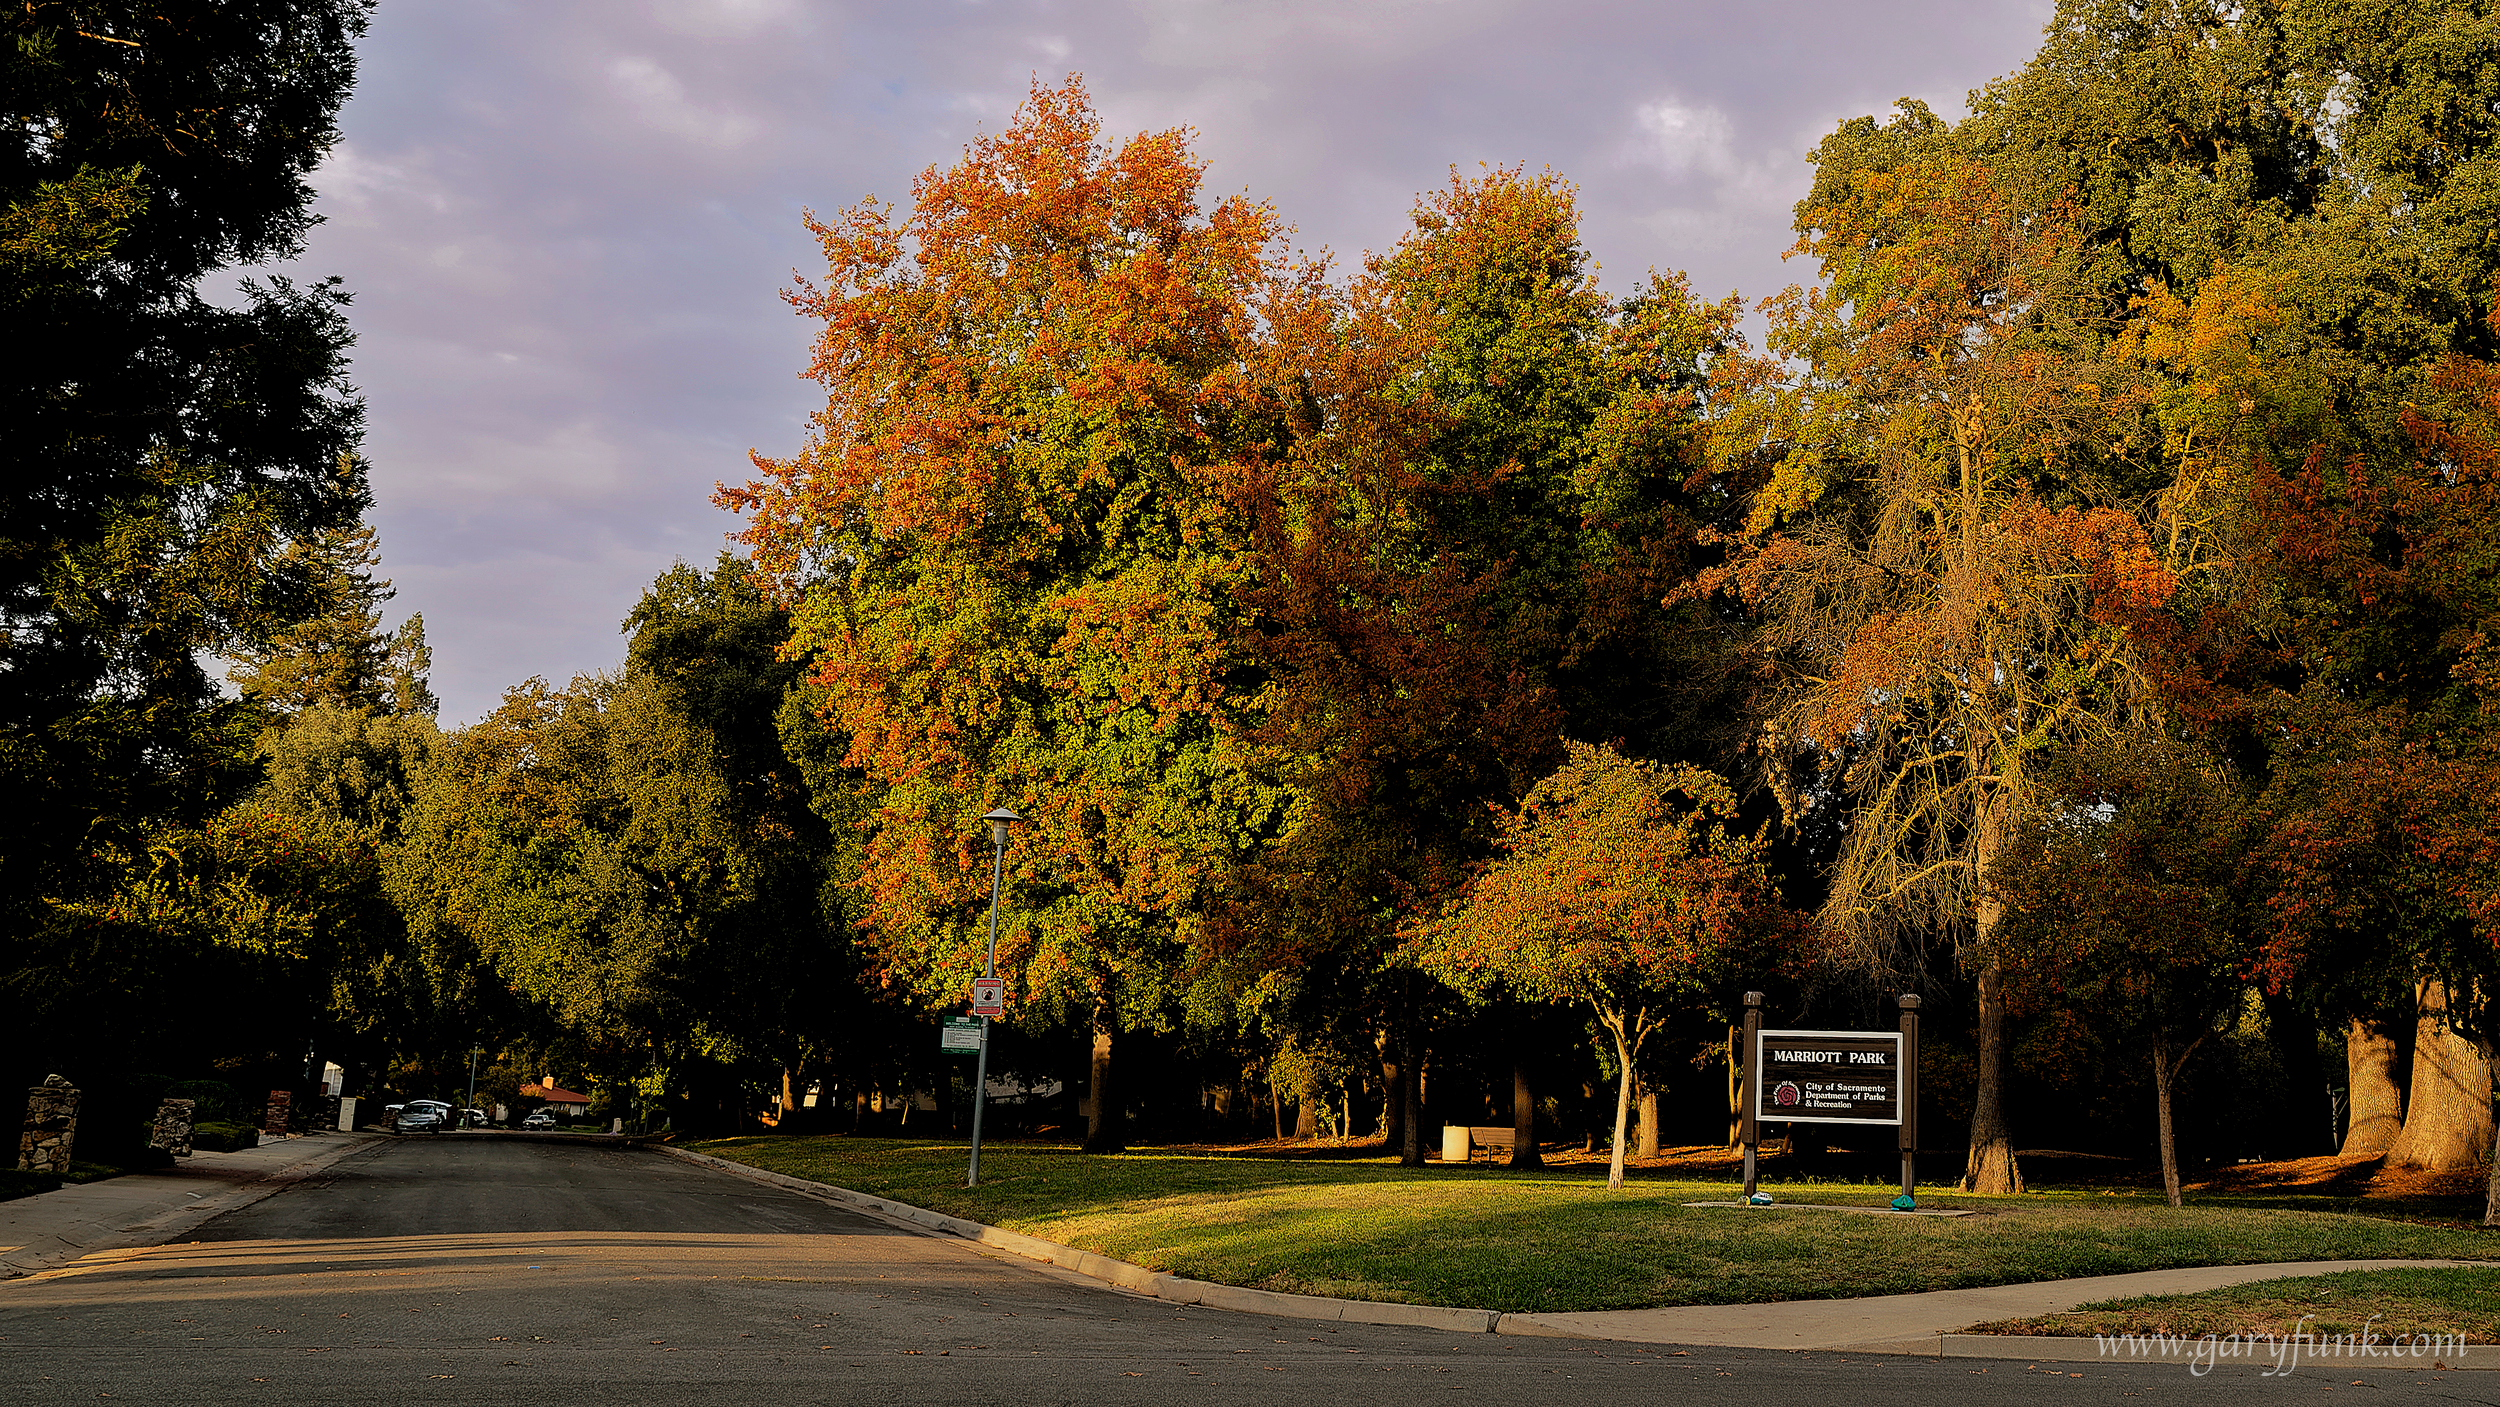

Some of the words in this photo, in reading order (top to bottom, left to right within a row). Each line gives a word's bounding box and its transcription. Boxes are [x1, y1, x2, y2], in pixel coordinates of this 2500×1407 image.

[1774, 1050, 1842, 1063] MARRIOTT
[1849, 1052, 1885, 1064] PARK
[1805, 1082, 1822, 1092] City
[1825, 1083, 1835, 1091] of
[1836, 1083, 1886, 1093] Sacramento
[1805, 1091, 1849, 1102] Department
[1852, 1092, 1861, 1100] of
[1863, 1092, 1886, 1101] Parks
[1805, 1099, 1812, 1108] &
[1813, 1100, 1852, 1108] Recreation
